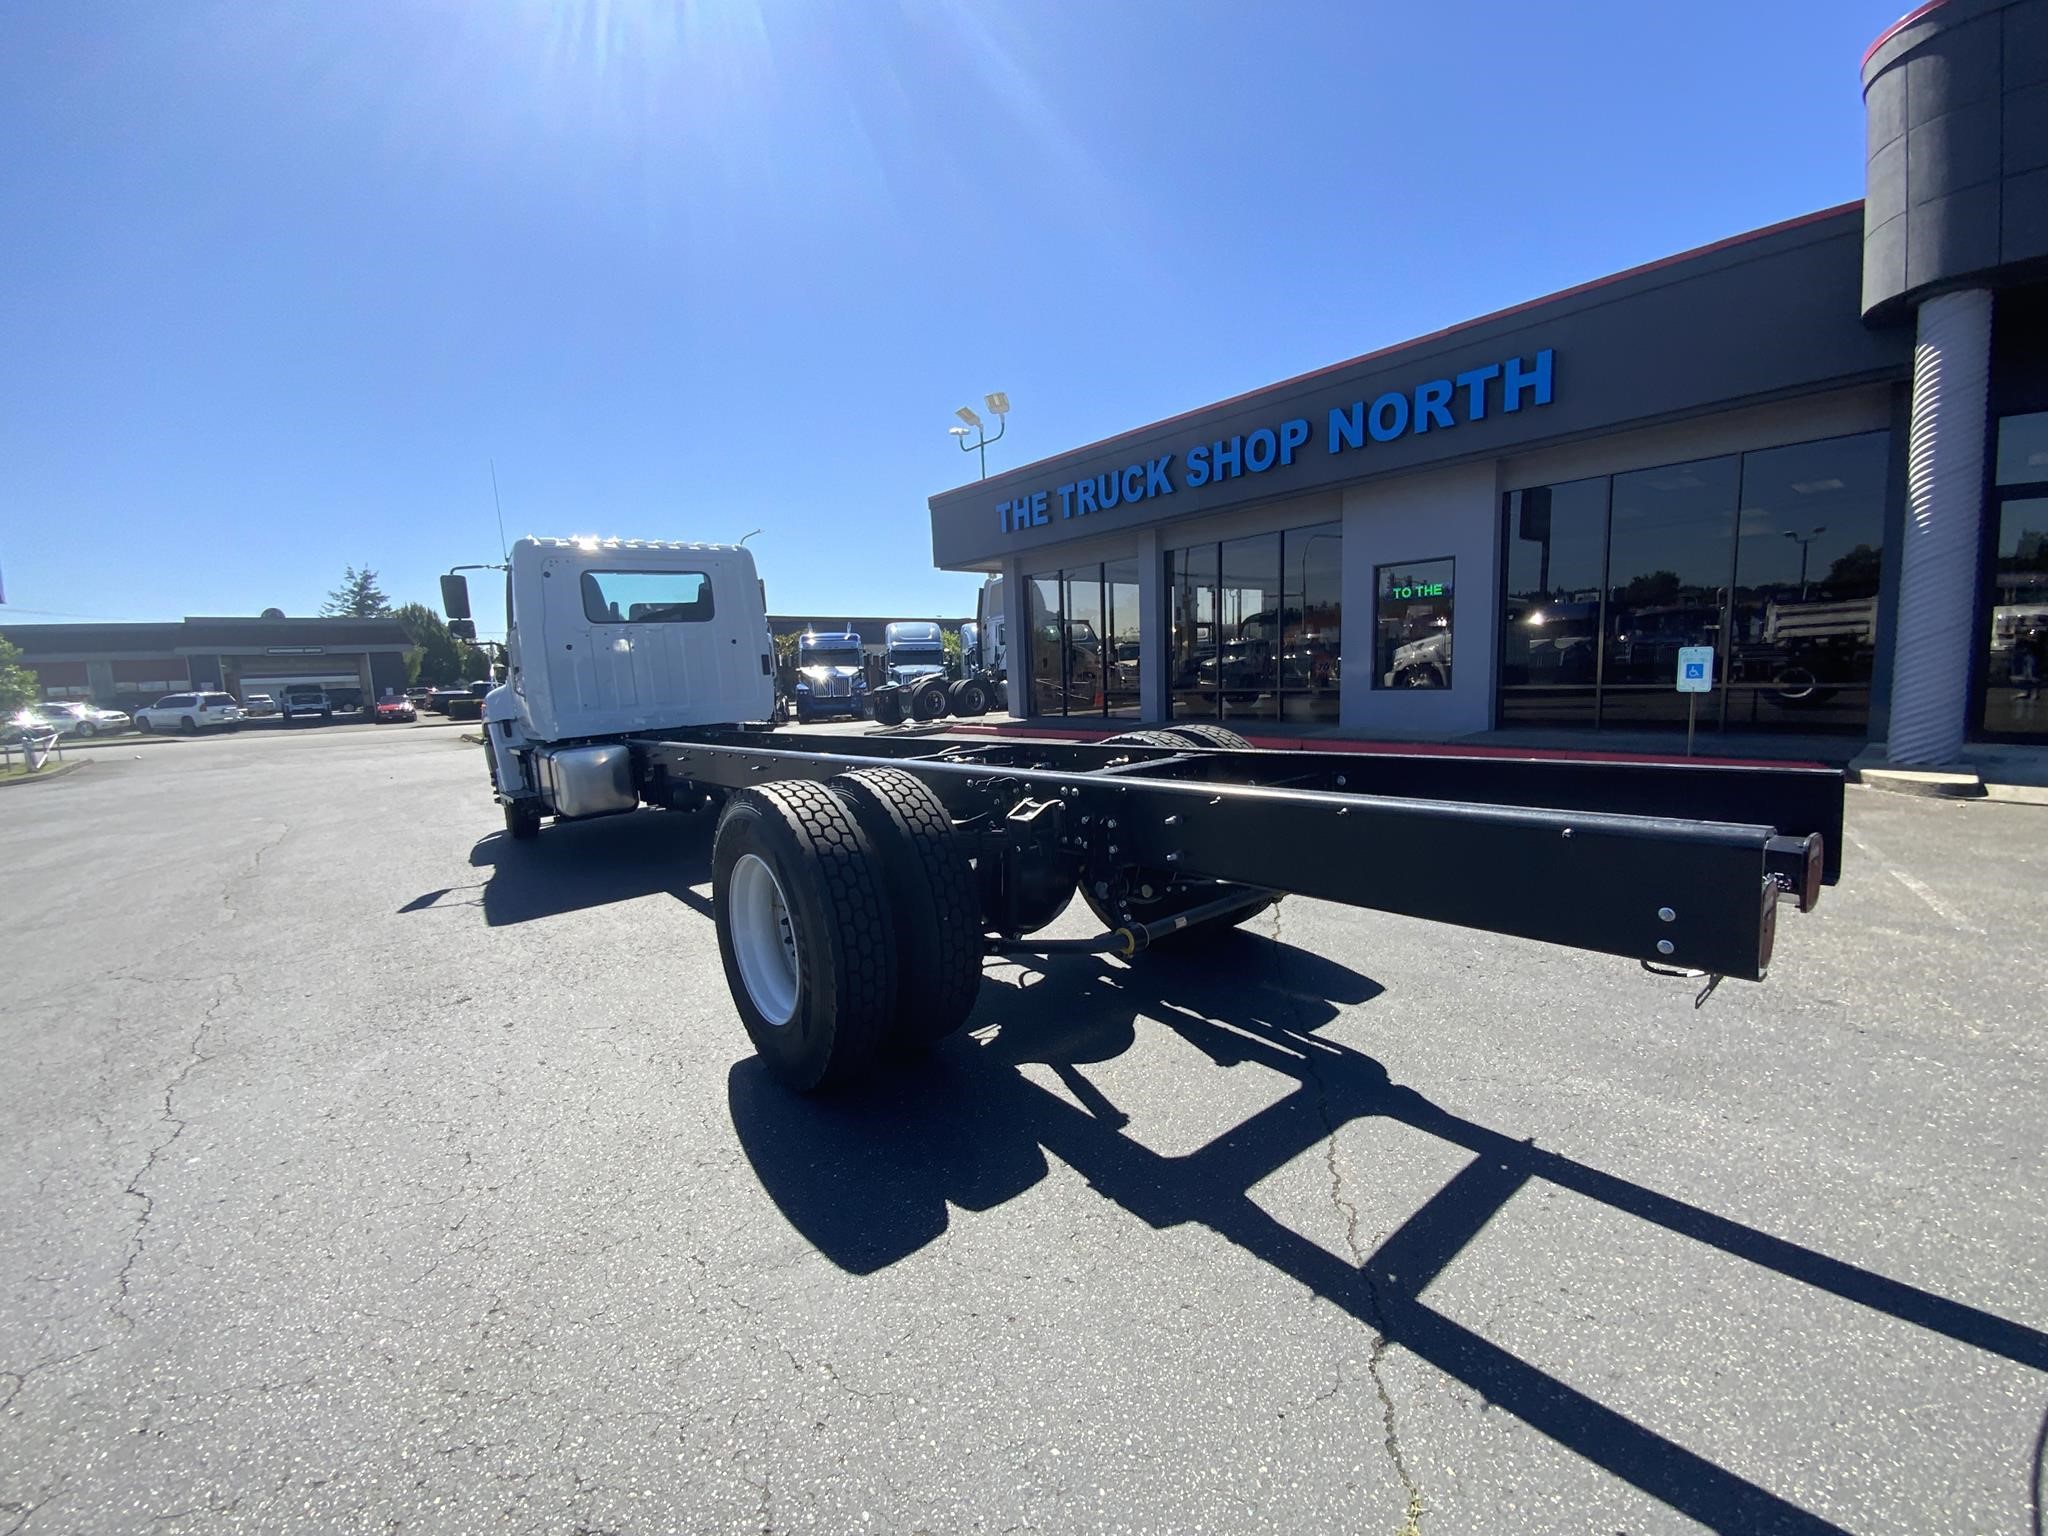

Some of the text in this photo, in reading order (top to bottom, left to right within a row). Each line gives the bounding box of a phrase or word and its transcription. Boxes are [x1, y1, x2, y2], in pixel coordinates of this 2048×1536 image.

[996, 348, 1556, 534] THE TRUCK SHOP NORTH
[1393, 583, 1443, 599] TO THE
